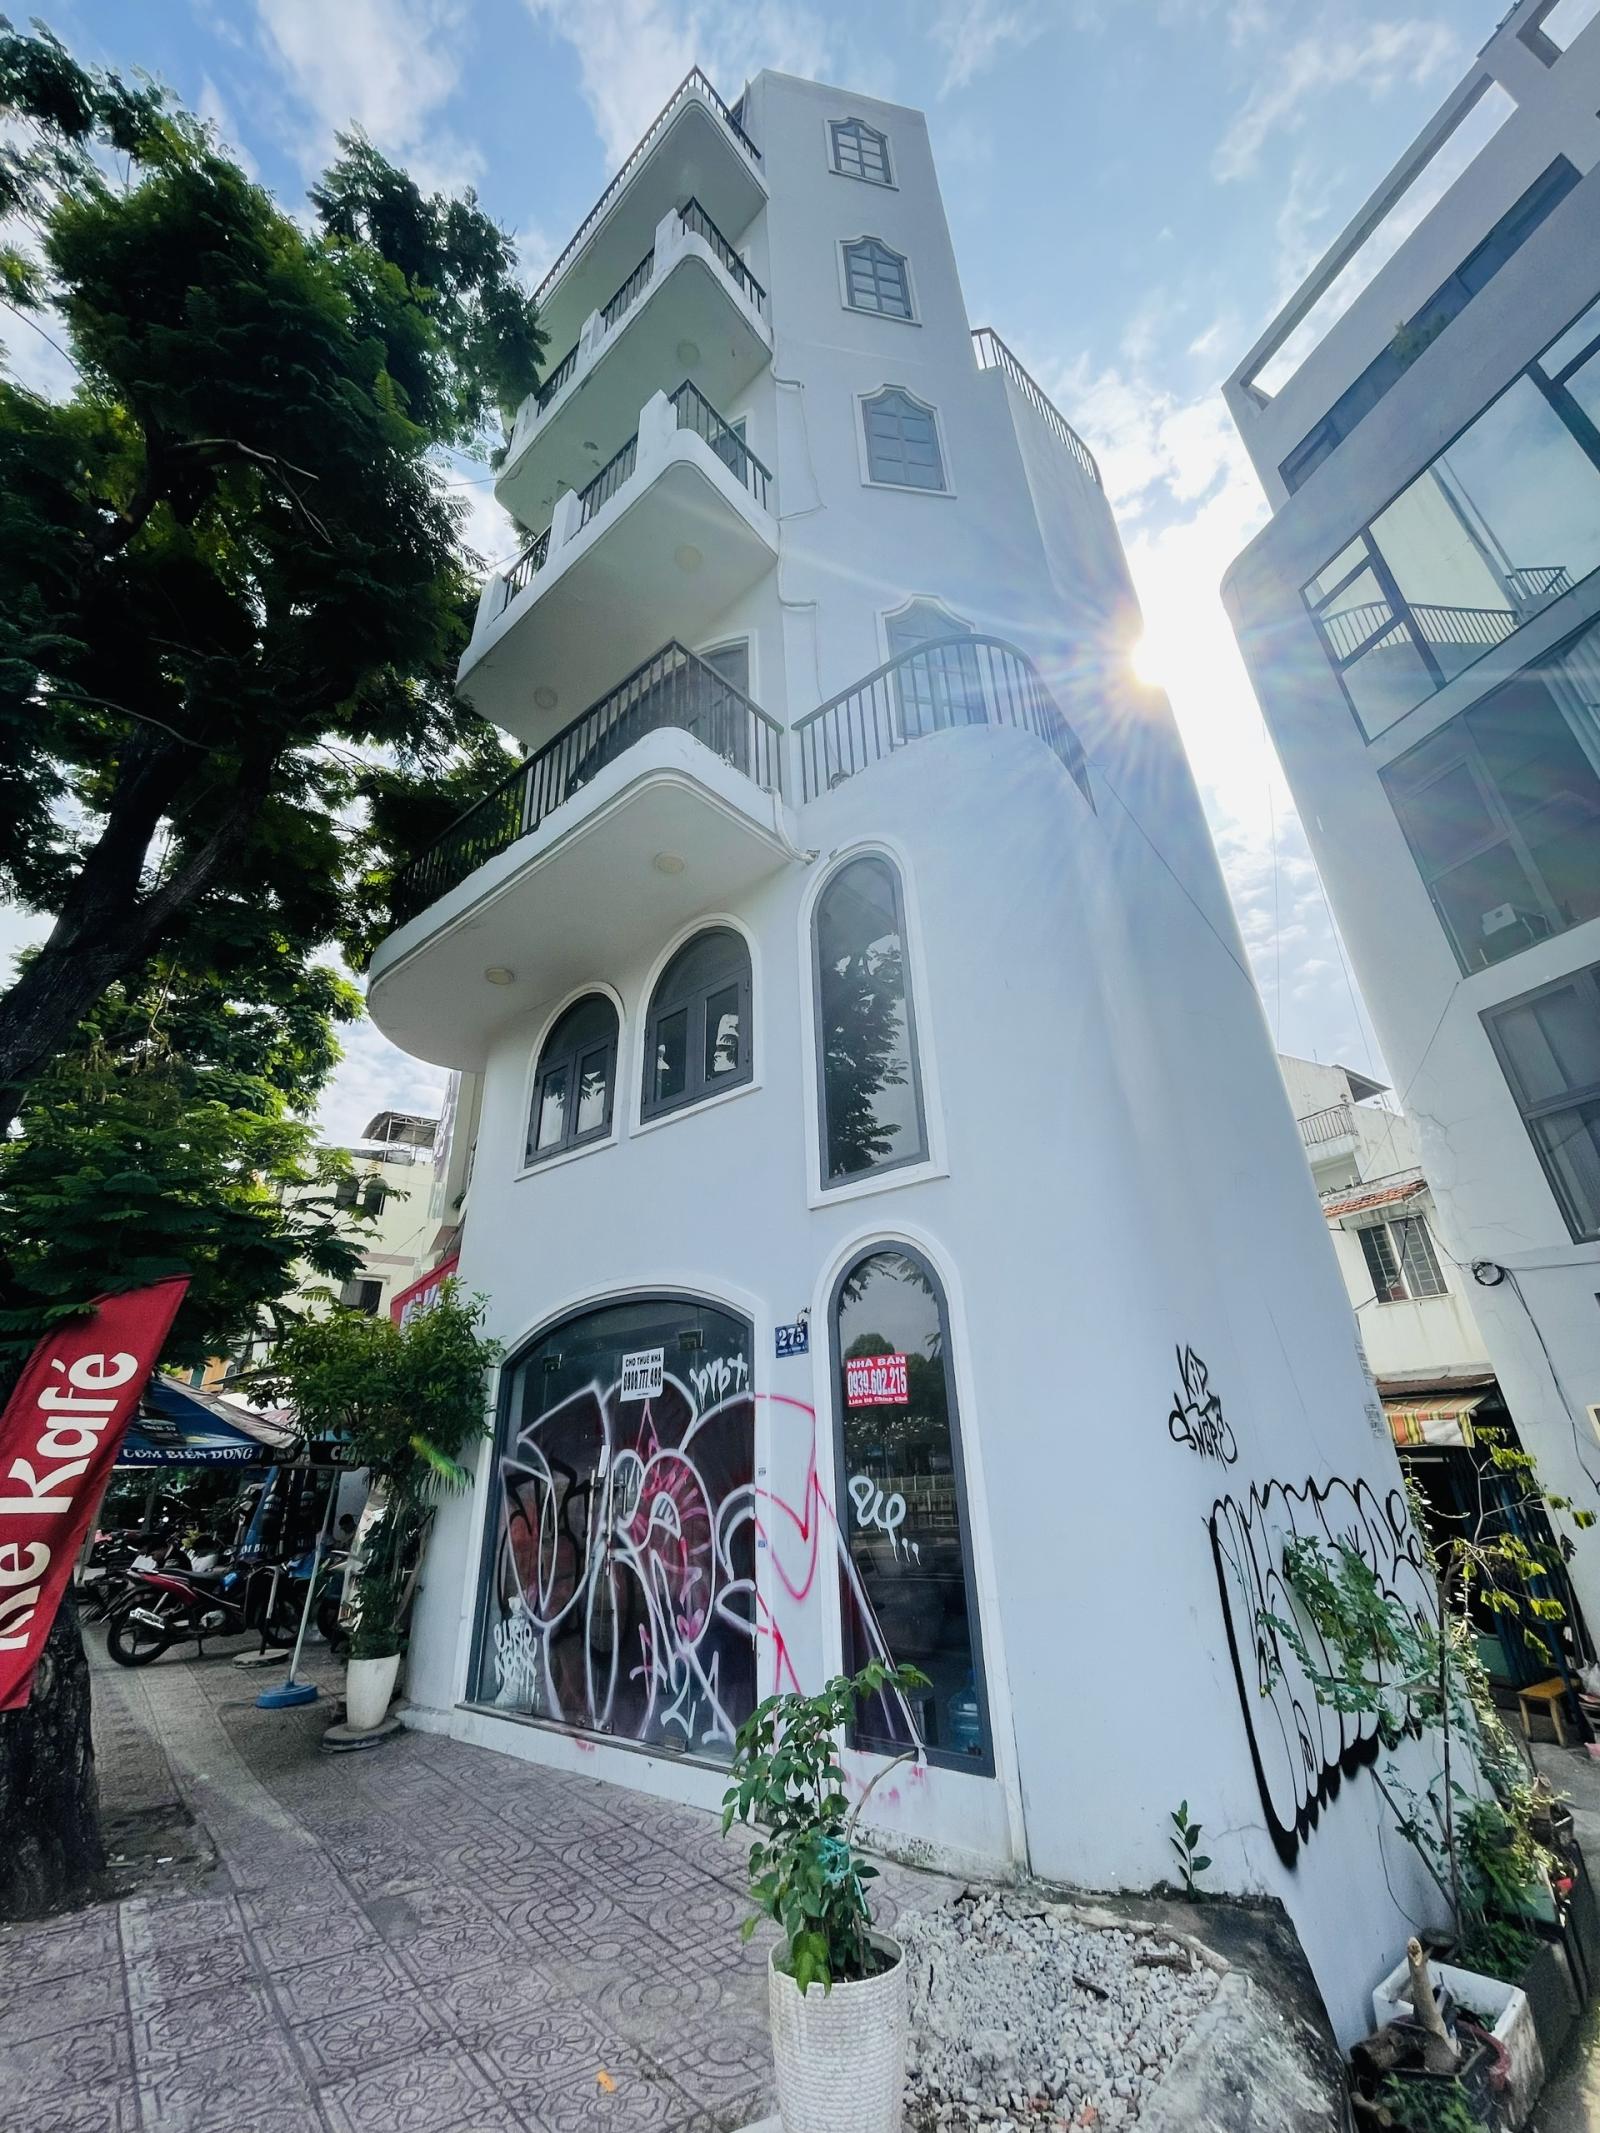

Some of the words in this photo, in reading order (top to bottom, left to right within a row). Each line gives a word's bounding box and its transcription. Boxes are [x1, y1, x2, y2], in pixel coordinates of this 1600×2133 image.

[778, 1326, 805, 1347] 275
[847, 1366, 907, 1397] 0939.602.215
[0, 1352, 138, 1514] Kafé
